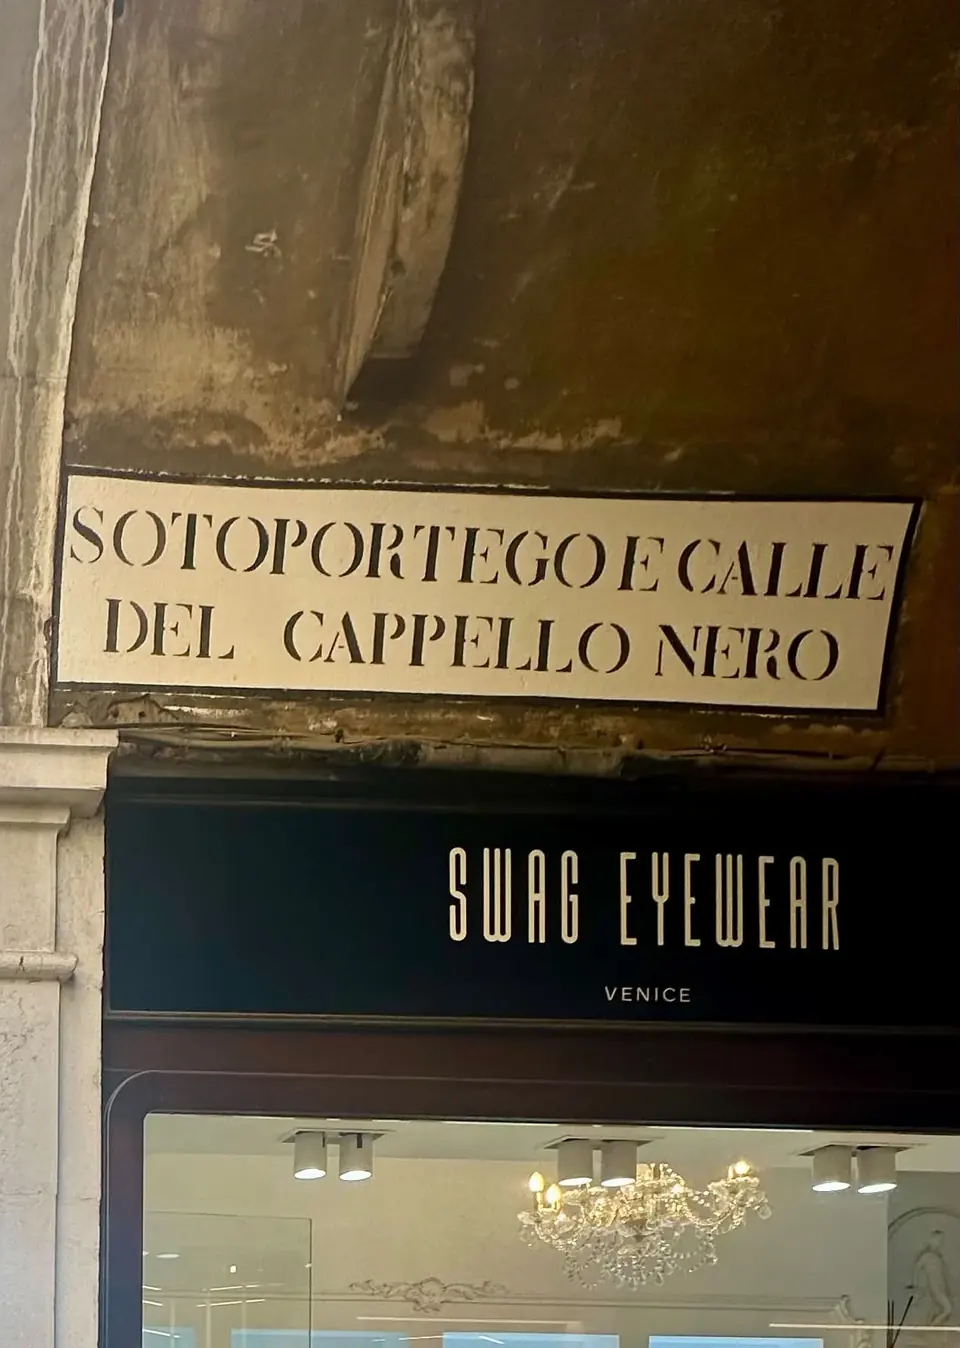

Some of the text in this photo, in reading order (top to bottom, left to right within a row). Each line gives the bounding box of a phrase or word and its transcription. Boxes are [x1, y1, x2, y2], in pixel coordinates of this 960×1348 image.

[69, 504, 895, 602] SOTOPORTEGO E CALLE
[104, 597, 839, 682] DEL CAPPELLO NERO
[449, 846, 840, 951] SWAG EYEWEAR
[604, 985, 692, 1003] VENICE
